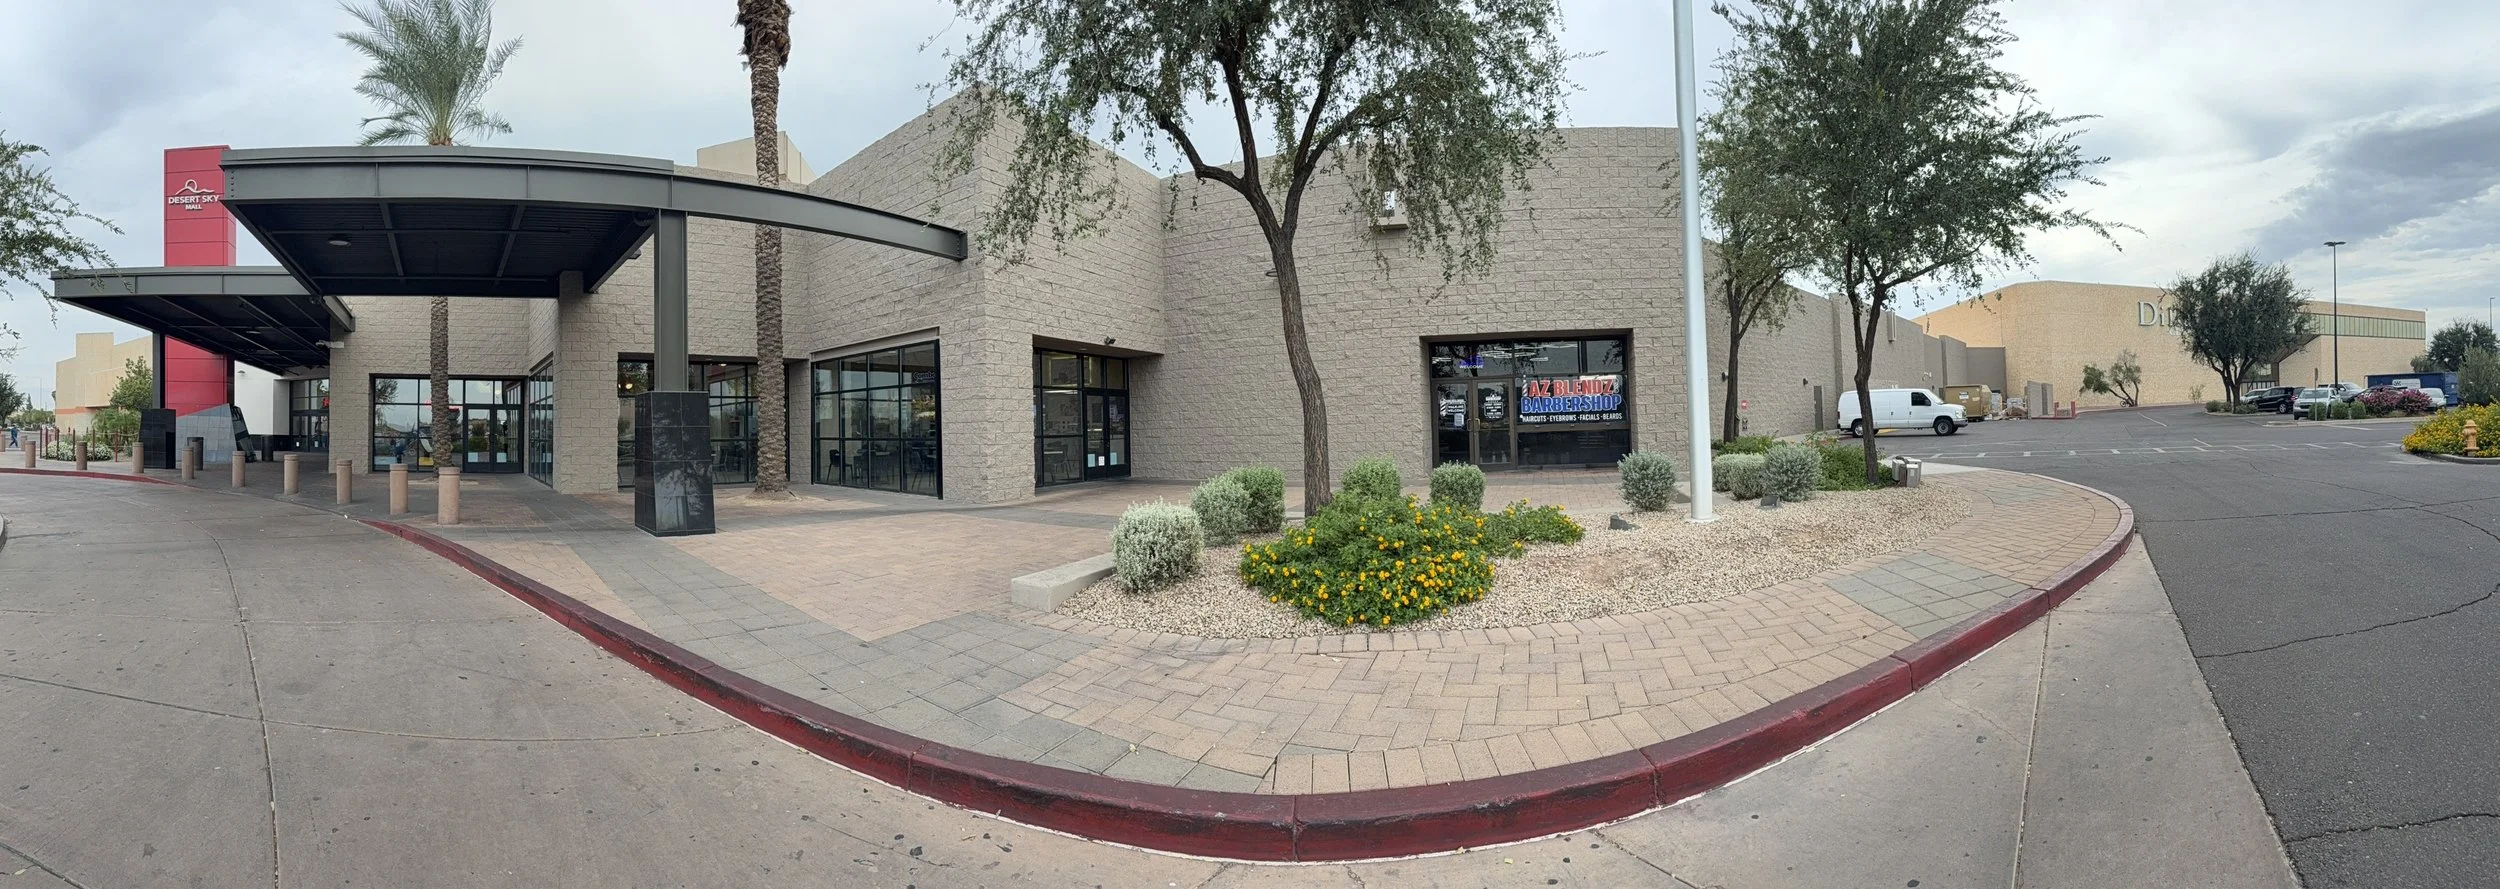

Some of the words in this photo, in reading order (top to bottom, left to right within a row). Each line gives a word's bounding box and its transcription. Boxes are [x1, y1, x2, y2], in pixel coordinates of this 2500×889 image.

[168, 196, 201, 204] DESERT
[202, 195, 220, 203] SKY
[1528, 380, 1550, 397] AZ
[1553, 378, 1614, 396] BLENDZ
[1521, 395, 1622, 413] BARBERSHOP
[1549, 414, 1577, 422] EYEBROWS
[1579, 413, 1601, 421] FACIALS
[1602, 412, 1622, 420] BEARDS
